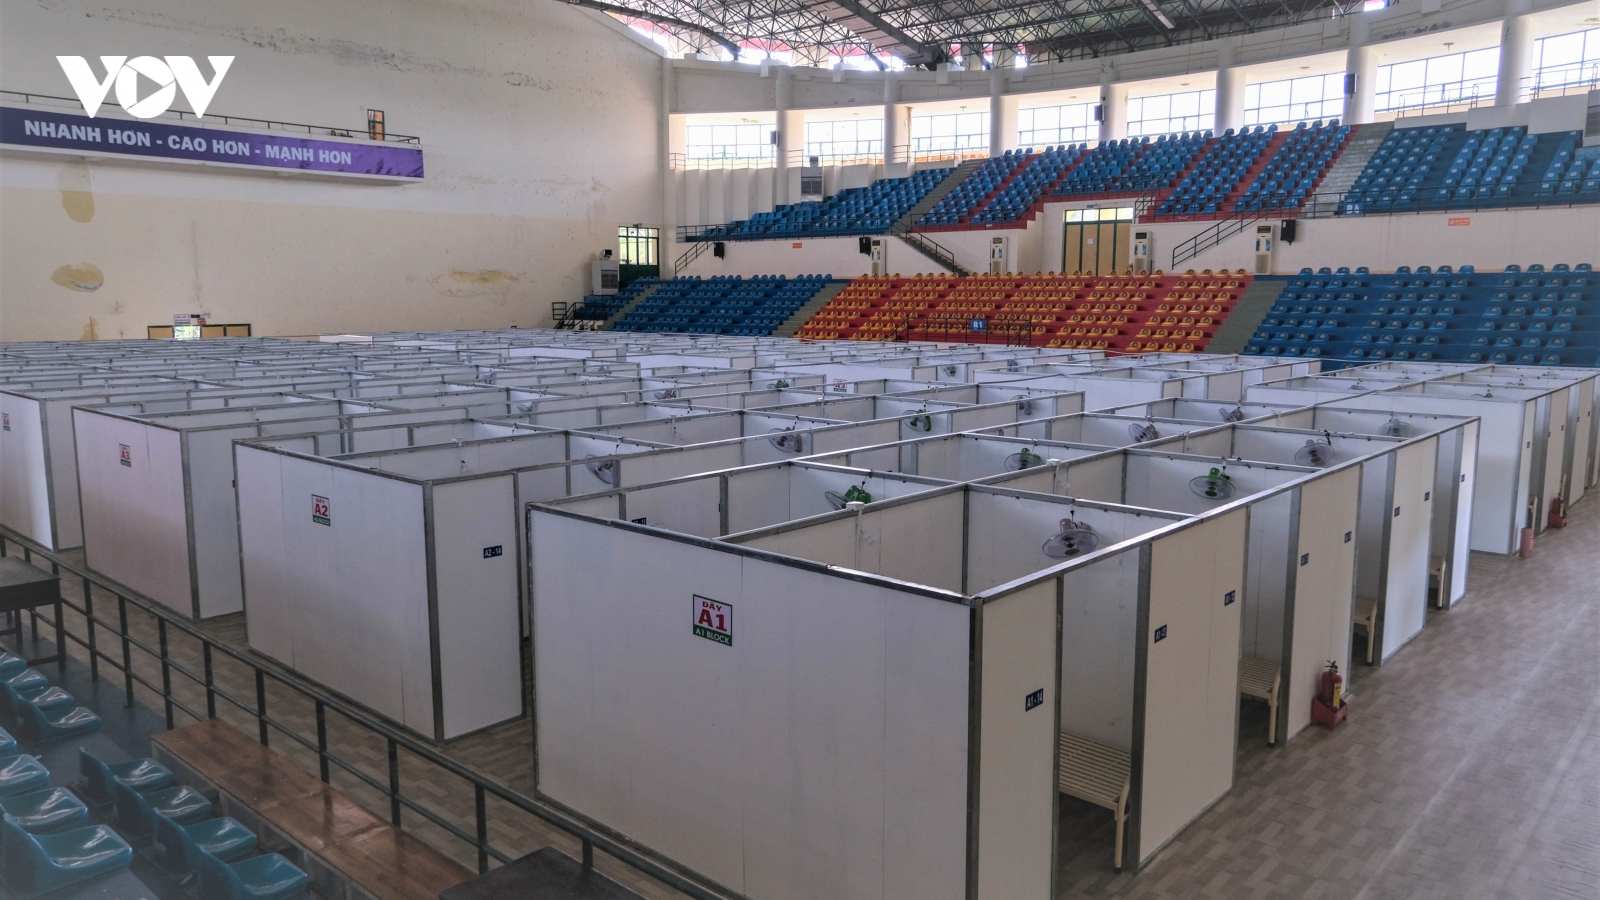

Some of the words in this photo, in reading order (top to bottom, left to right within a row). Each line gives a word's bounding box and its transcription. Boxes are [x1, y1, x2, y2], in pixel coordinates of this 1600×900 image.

[24, 119, 102, 143] NHANH
[107, 129, 151, 147] HƠN
[167, 135, 207, 153] CAO
[212, 139, 250, 156] HƠN
[265, 144, 314, 162] MẠNH
[315, 503, 329, 517] A2
[698, 609, 727, 632] A1
[695, 628, 704, 636] A1
[707, 631, 730, 644] BLOCK
